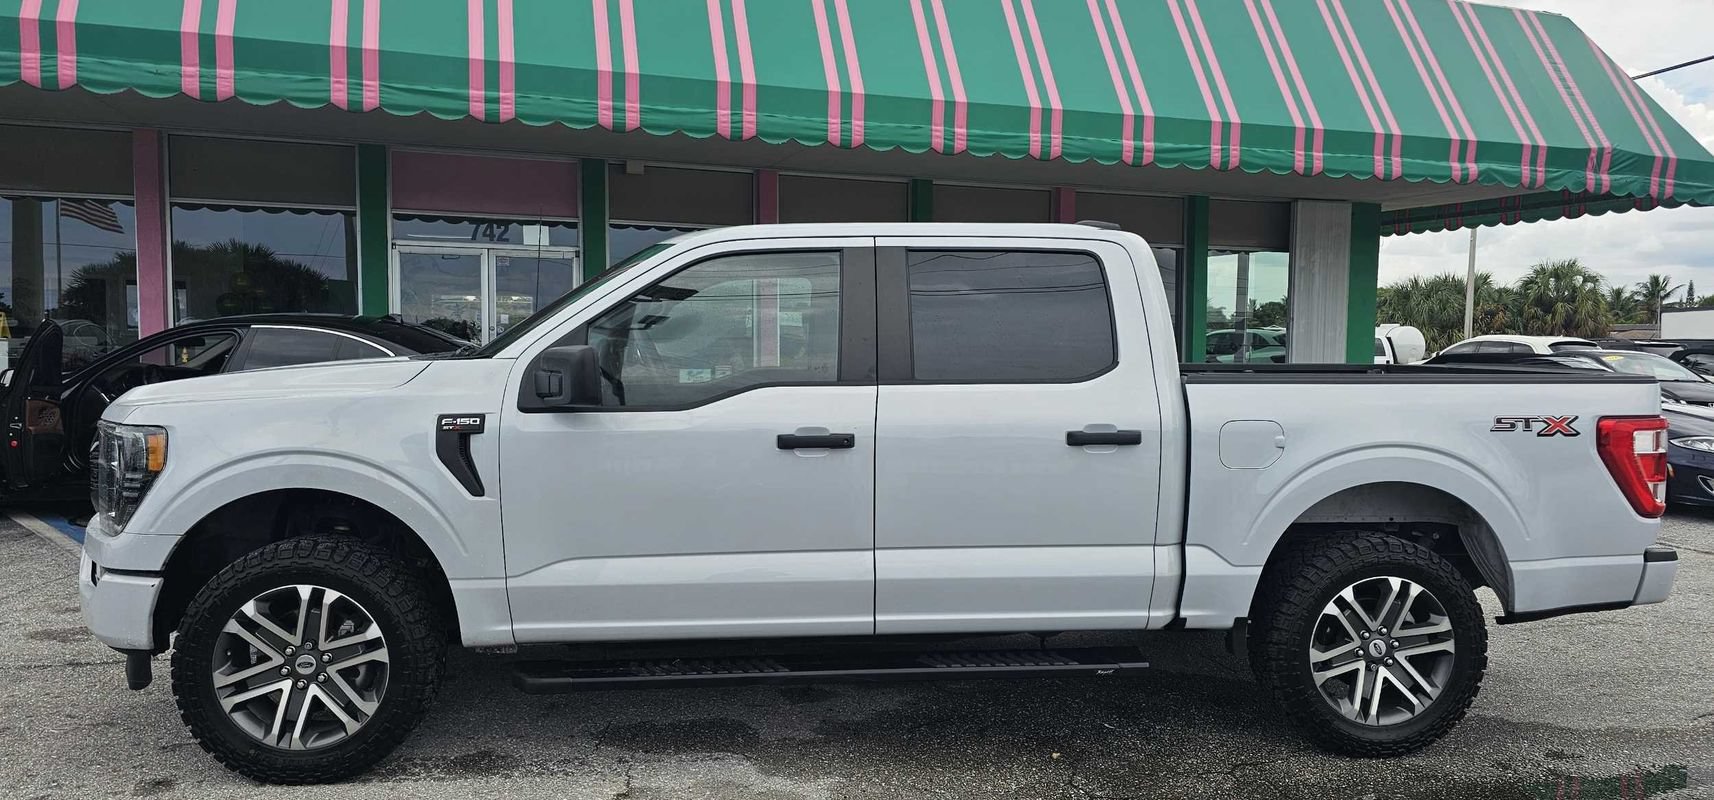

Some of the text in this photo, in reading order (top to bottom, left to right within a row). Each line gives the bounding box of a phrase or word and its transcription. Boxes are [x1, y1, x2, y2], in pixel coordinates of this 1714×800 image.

[469, 221, 509, 242] 742
[441, 417, 480, 425] F-150
[1489, 415, 1581, 437] STX
